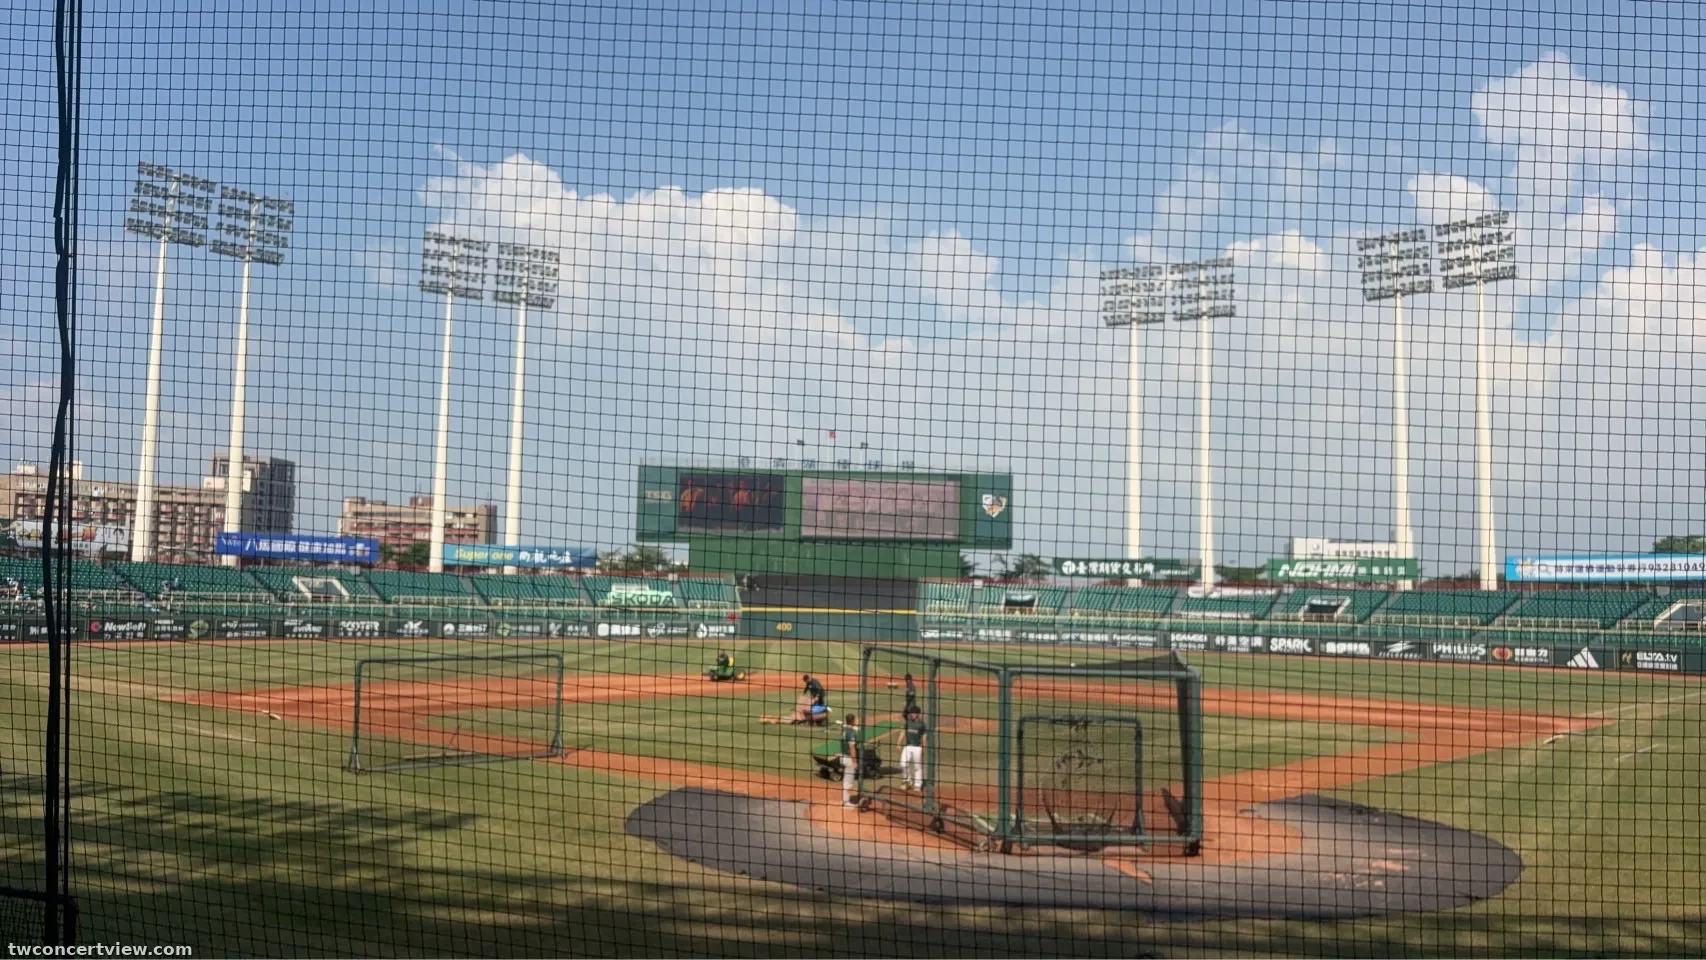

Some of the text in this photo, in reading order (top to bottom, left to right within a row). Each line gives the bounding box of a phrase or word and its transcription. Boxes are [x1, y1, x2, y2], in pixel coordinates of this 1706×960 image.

[492, 552, 513, 561] one
[776, 622, 793, 632] 400
[1270, 637, 1312, 653] SPARK
[1433, 642, 1486, 656] PHILIPS
